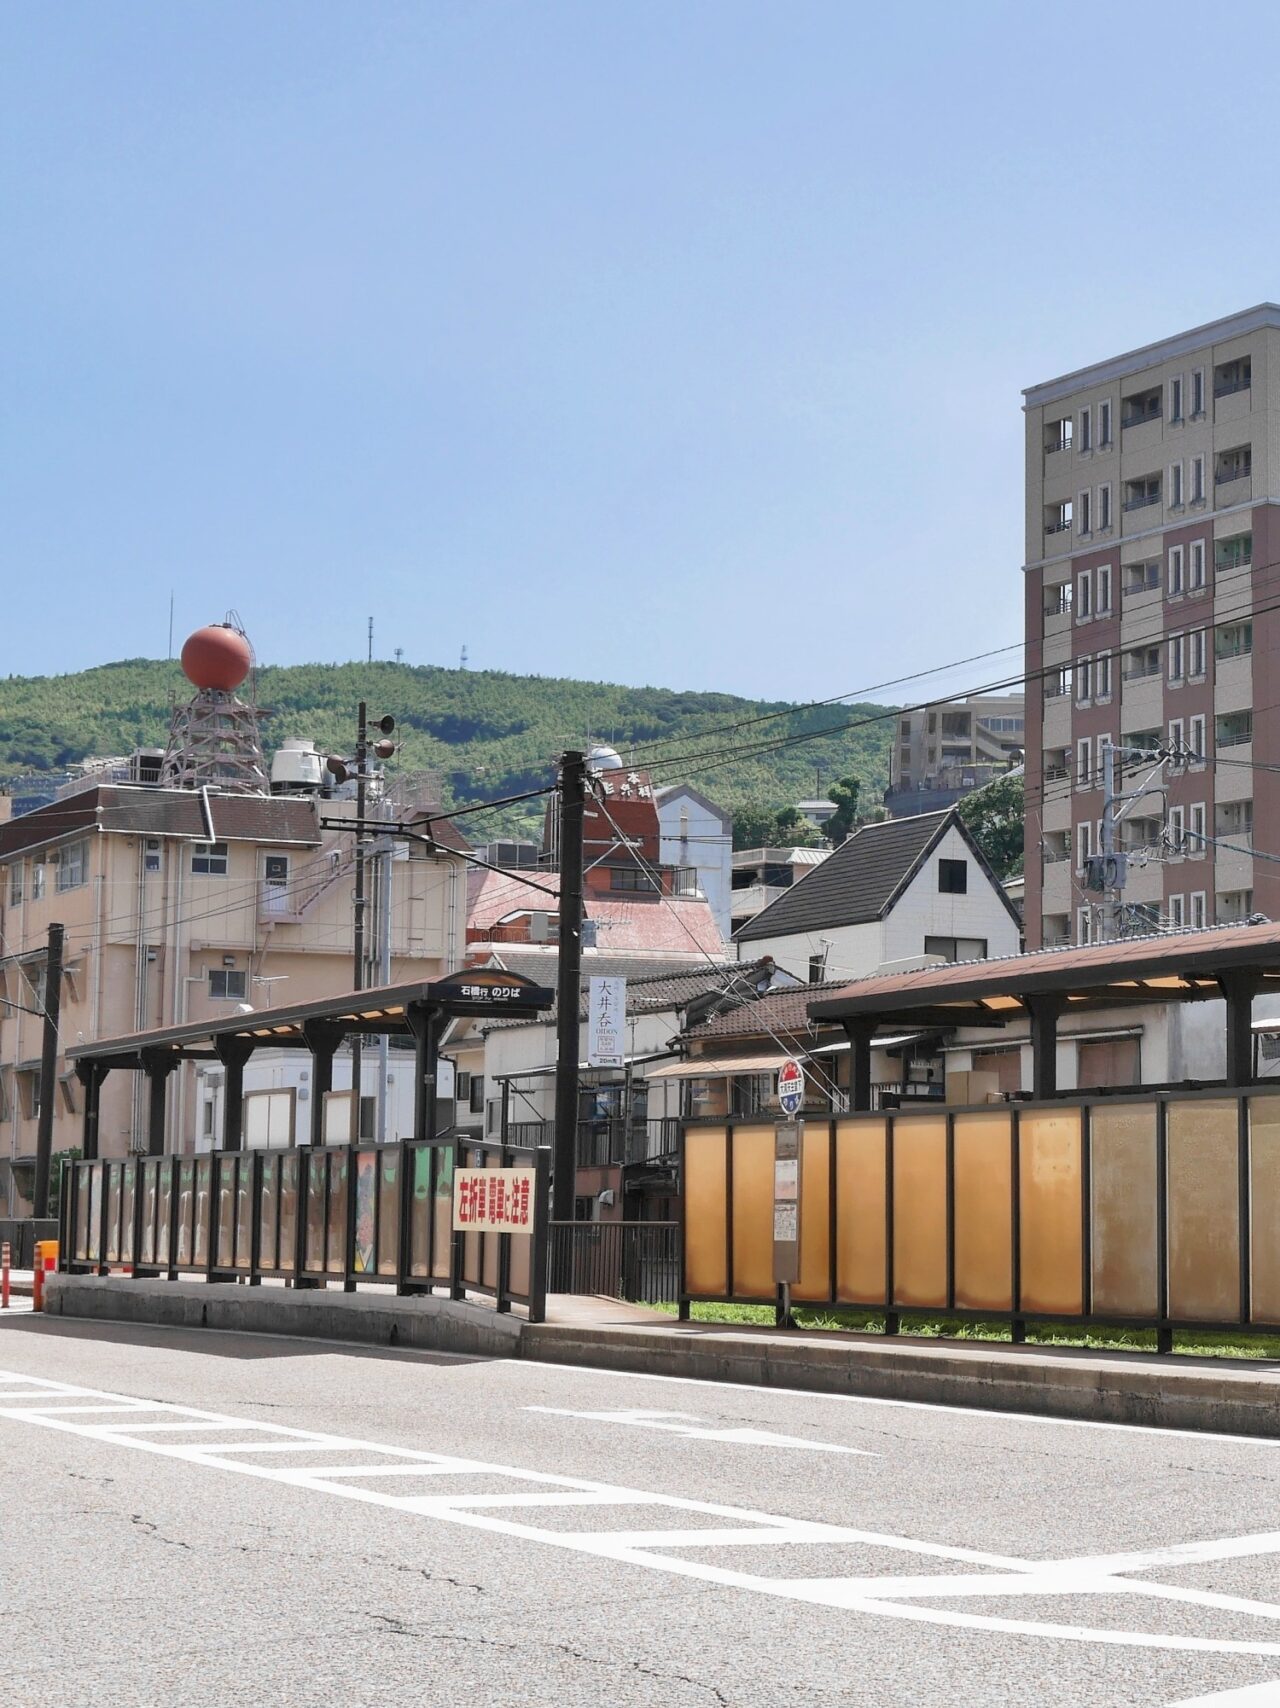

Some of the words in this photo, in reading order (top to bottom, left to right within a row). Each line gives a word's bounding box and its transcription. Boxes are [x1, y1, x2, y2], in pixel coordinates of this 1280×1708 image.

[460, 985, 488, 997] 石橋行
[491, 987, 521, 998] のりば
[596, 980, 612, 1028] 大井呑
